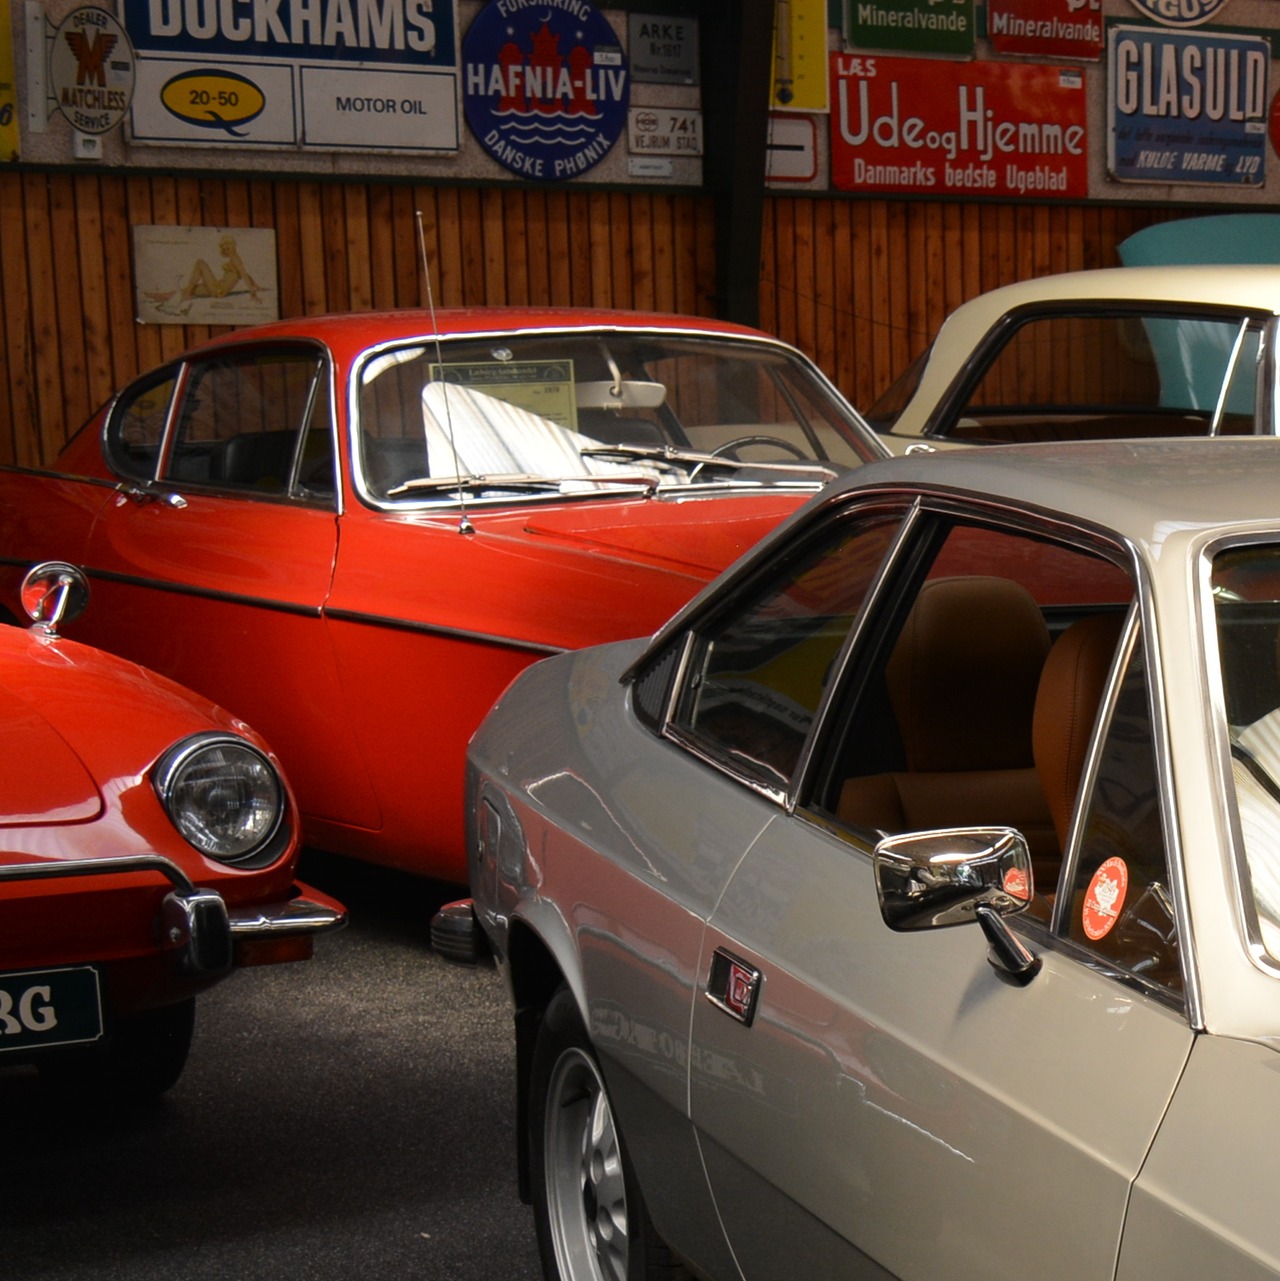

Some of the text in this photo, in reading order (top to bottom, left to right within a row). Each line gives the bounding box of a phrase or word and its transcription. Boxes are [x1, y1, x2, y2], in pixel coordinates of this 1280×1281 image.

[73, 11, 108, 30] DEALER
[150, 0, 437, 52] DUCKHAMS
[857, 4, 967, 32] Mineralvande
[992, 12, 1099, 42] Mineralvande
[640, 23, 684, 41] ARKE
[837, 57, 877, 78] LÆS
[466, 63, 627, 101] HAFNIA-LIV
[1117, 39, 1266, 121] GLASULD
[62, 88, 126, 111] MATCHLESS
[190, 89, 239, 107] 20-50
[336, 97, 427, 115] MOTOR OIL
[74, 110, 111, 129] SERVICE
[670, 117, 697, 134] 741
[838, 79, 1085, 161] Ude og Hjemme
[484, 129, 612, 177] DANSKE PHØNIX
[1136, 150, 1178, 170] KULDE
[1182, 153, 1227, 172] VARME
[1235, 155, 1261, 174] LYD
[853, 158, 1068, 194] Danmarks bedste Ugeblad
